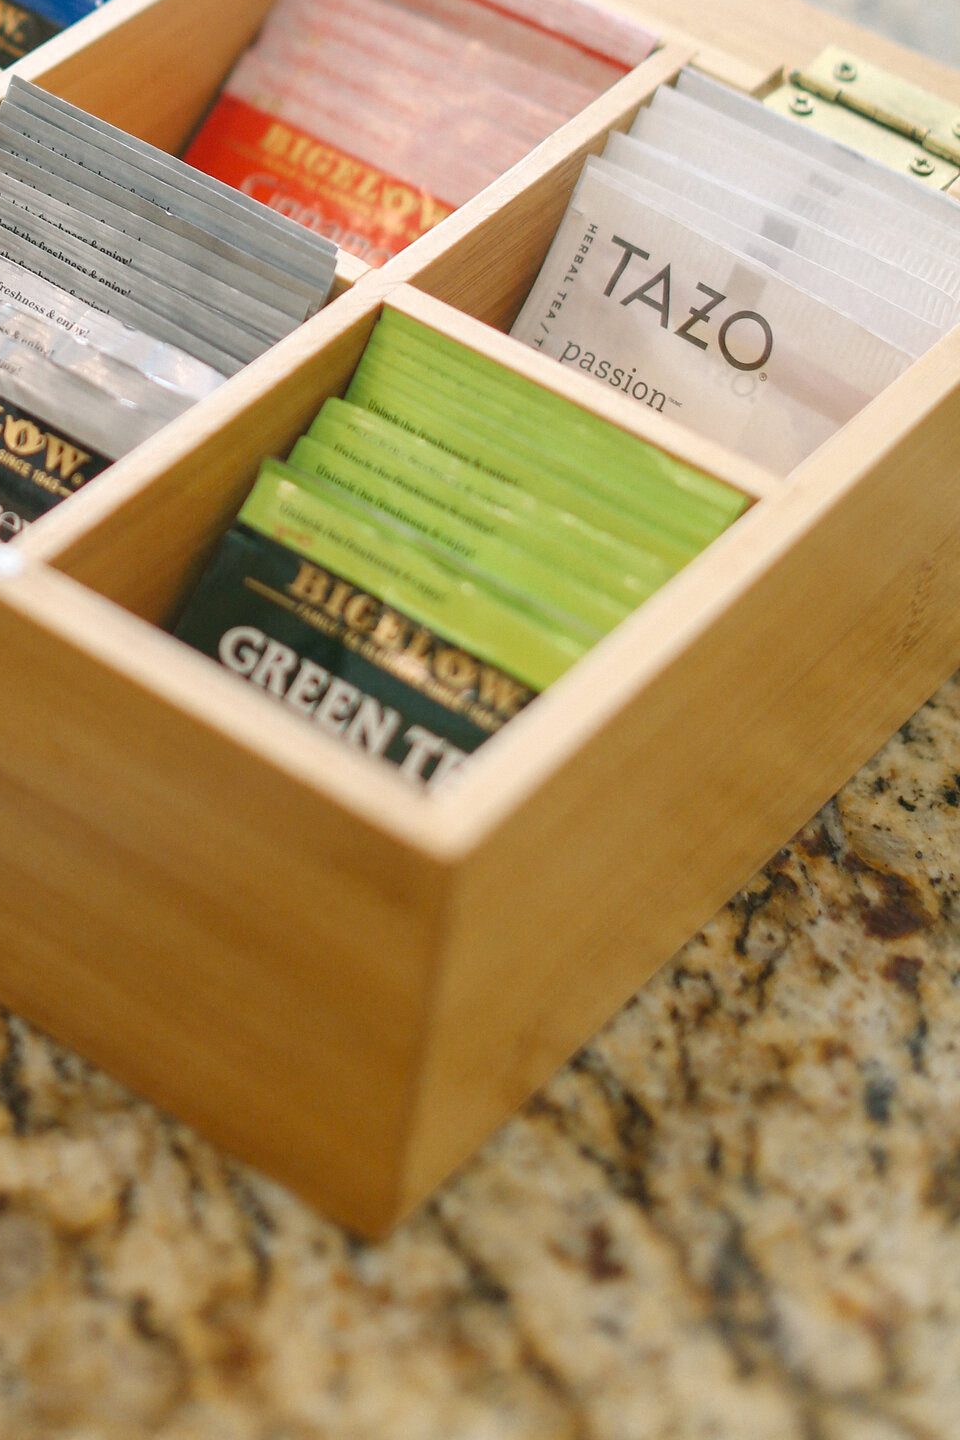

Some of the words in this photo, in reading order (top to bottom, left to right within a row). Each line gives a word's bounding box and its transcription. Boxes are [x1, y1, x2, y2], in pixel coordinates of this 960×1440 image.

[564, 223, 598, 282] HERBAL
[604, 235, 773, 371] TAZO
[46, 310, 56, 320] &
[56, 315, 90, 340] enjoy!
[558, 340, 666, 413] passion
[287, 561, 526, 711] BIGELOW
[218, 625, 402, 757] GREEN
